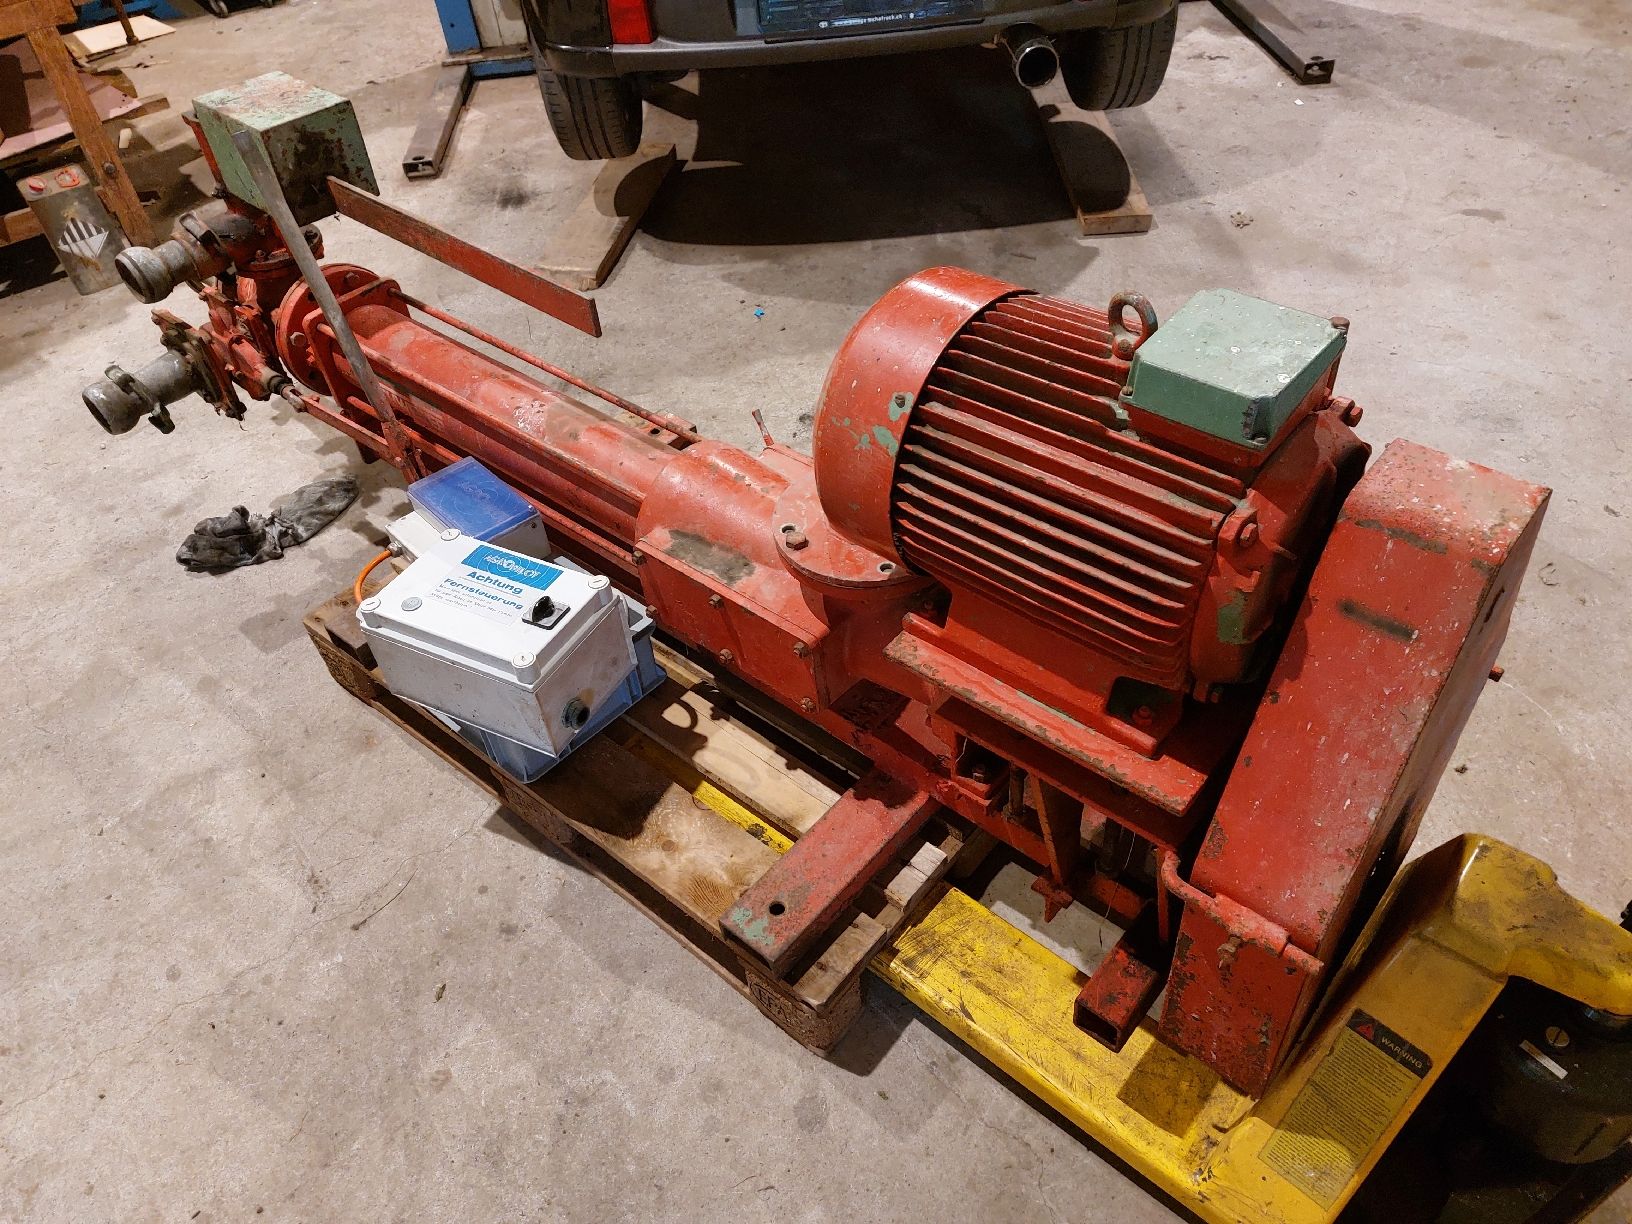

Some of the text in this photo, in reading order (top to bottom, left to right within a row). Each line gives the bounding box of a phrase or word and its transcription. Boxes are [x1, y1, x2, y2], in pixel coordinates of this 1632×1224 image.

[444, 578, 524, 610] Fernsteuerung
[466, 571, 524, 595] Achtung
[1381, 1036, 1422, 1069] WARNING
